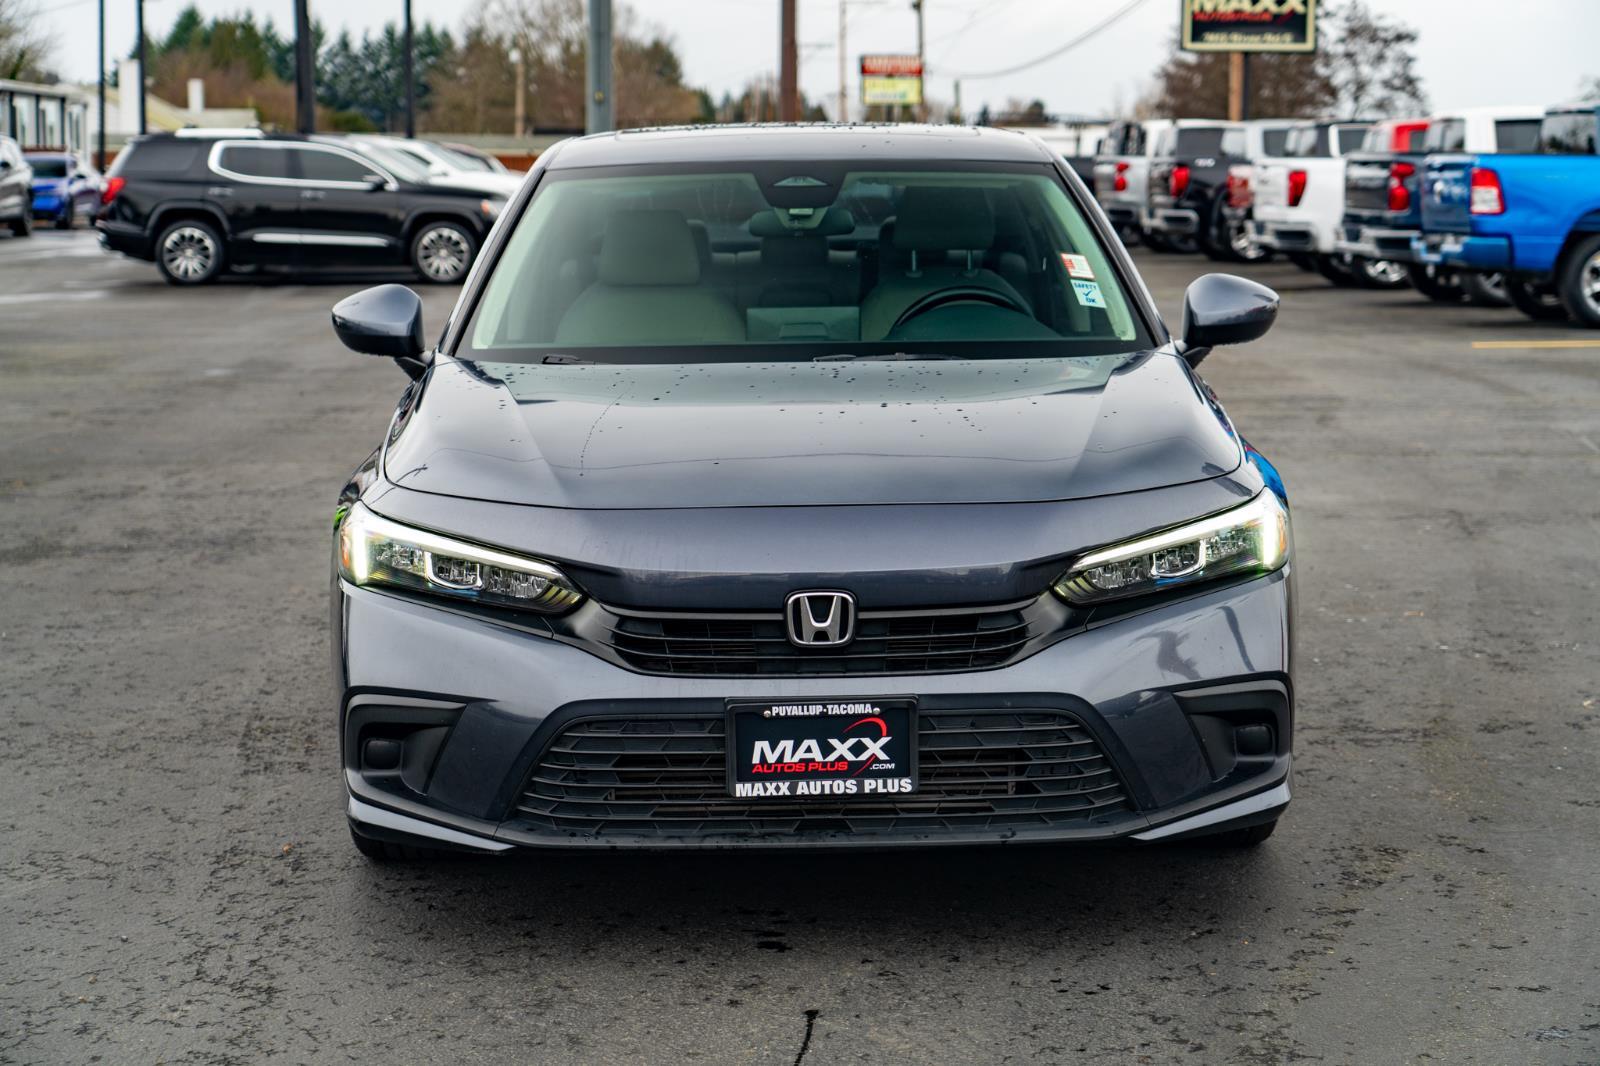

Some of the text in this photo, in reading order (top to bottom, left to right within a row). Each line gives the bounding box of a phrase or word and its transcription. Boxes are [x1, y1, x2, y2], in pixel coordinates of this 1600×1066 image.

[1193, 0, 1306, 14] MAXX
[752, 737, 892, 763] MAXX
[752, 763, 806, 774] AUTOS
[808, 761, 848, 772] PLUS
[735, 778, 912, 797] MAXX AUTOS PLUS
